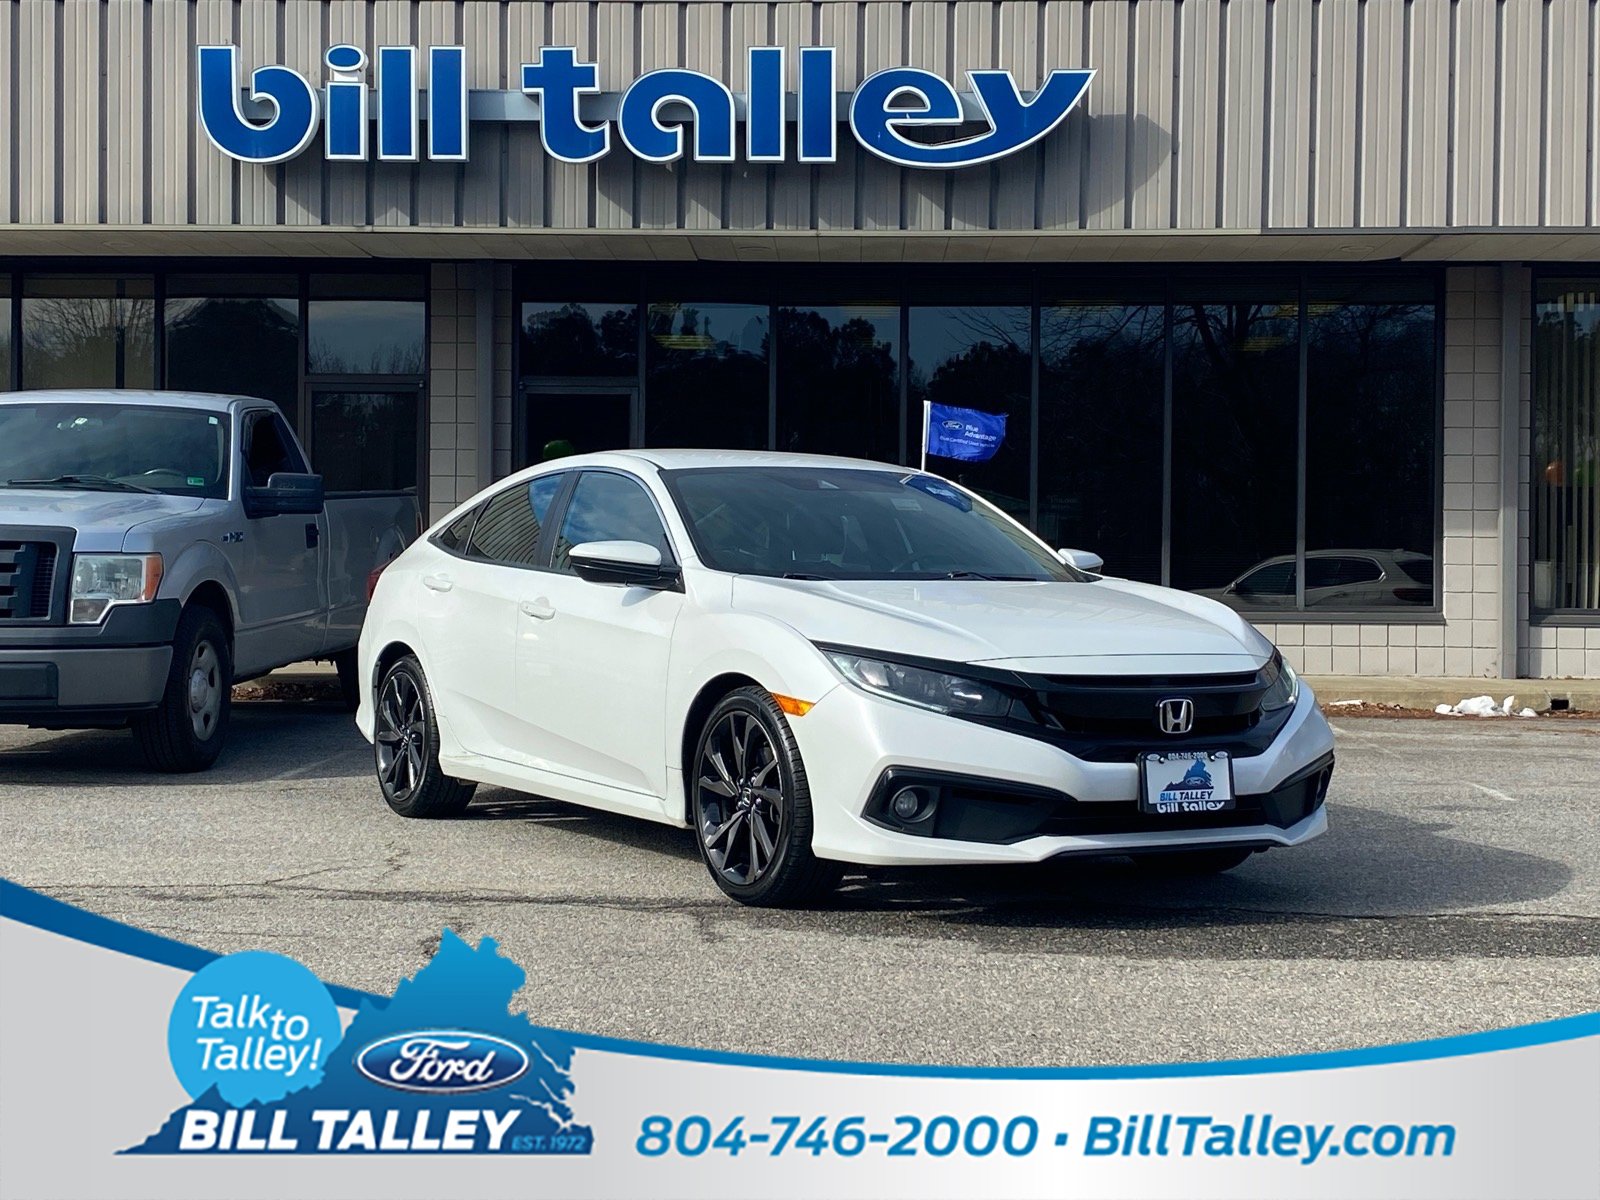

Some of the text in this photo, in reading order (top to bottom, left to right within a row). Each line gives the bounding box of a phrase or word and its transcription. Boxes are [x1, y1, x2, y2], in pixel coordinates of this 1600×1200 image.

[197, 44, 1098, 168] bill talley
[964, 431, 997, 441] Advantage
[1160, 790, 1214, 802] BILL TALLEY
[1182, 801, 1225, 812] talley
